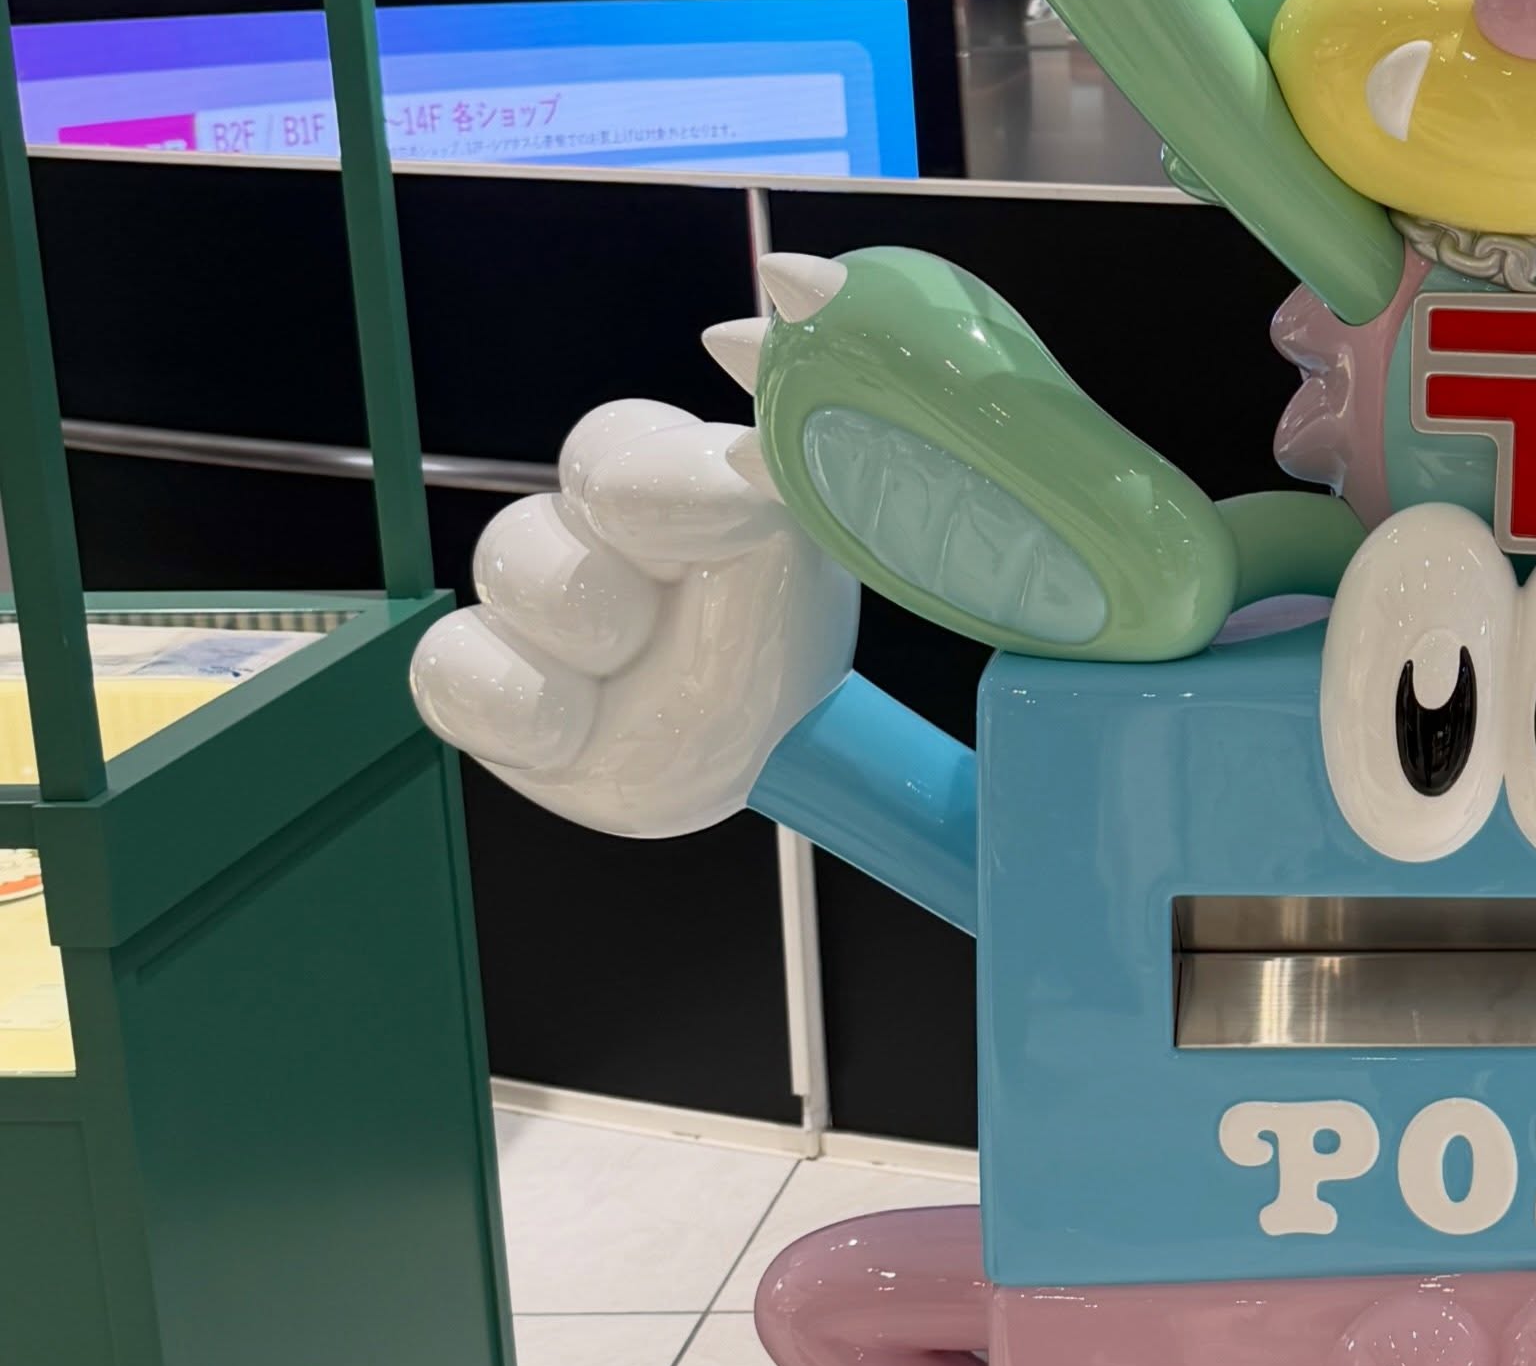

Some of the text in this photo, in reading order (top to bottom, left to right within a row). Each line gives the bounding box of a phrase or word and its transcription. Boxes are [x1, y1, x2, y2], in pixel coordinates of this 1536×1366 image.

[214, 119, 256, 152] B2F
[283, 113, 327, 147] B1F
[452, 93, 562, 133] 各ショップ
